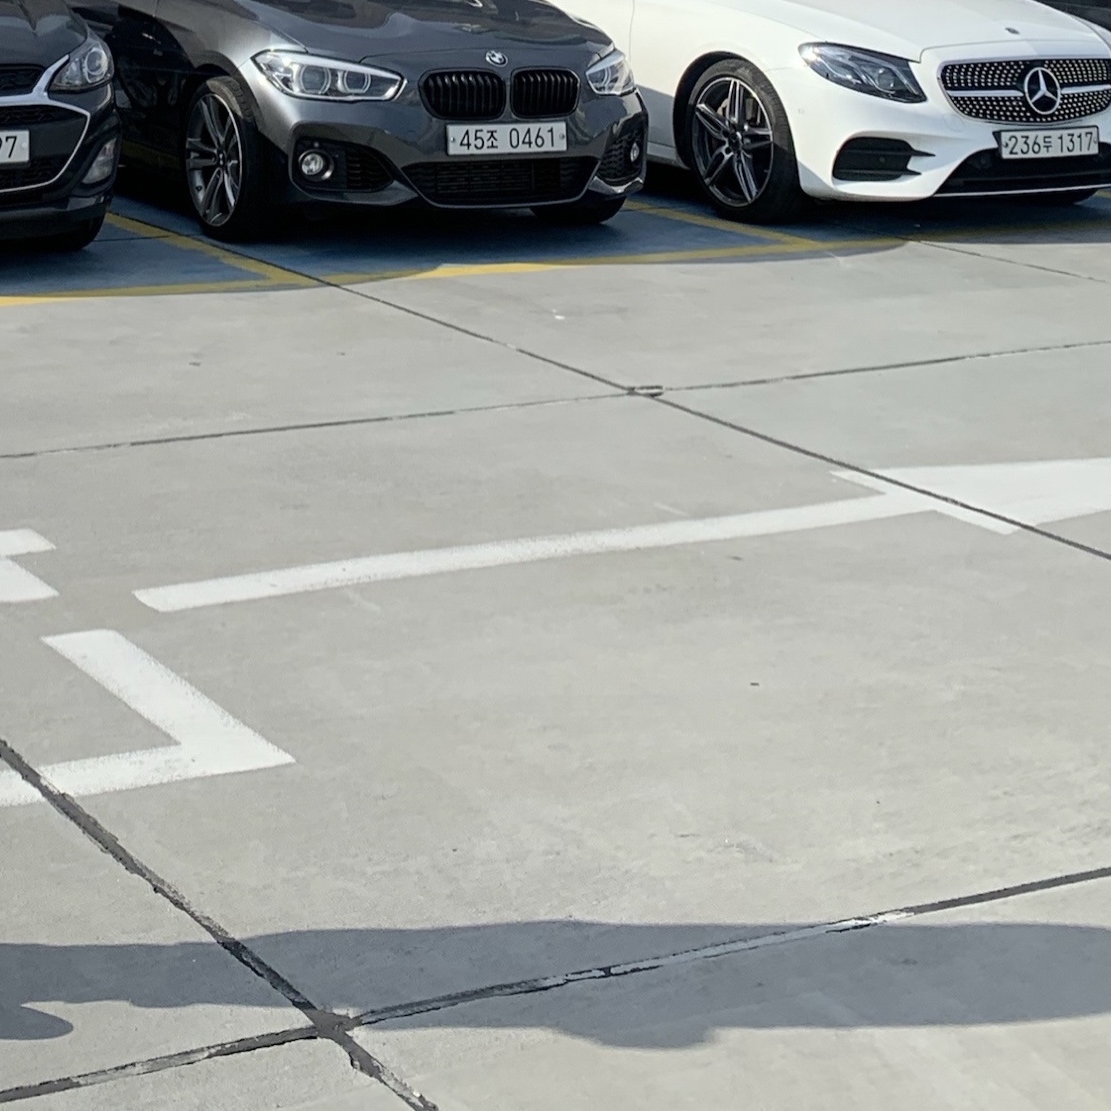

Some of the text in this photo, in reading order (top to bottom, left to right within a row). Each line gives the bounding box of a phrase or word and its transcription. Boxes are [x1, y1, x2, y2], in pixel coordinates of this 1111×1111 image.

[459, 126, 555, 150] 45조 0461
[1008, 131, 1093, 155] 236두 1317
